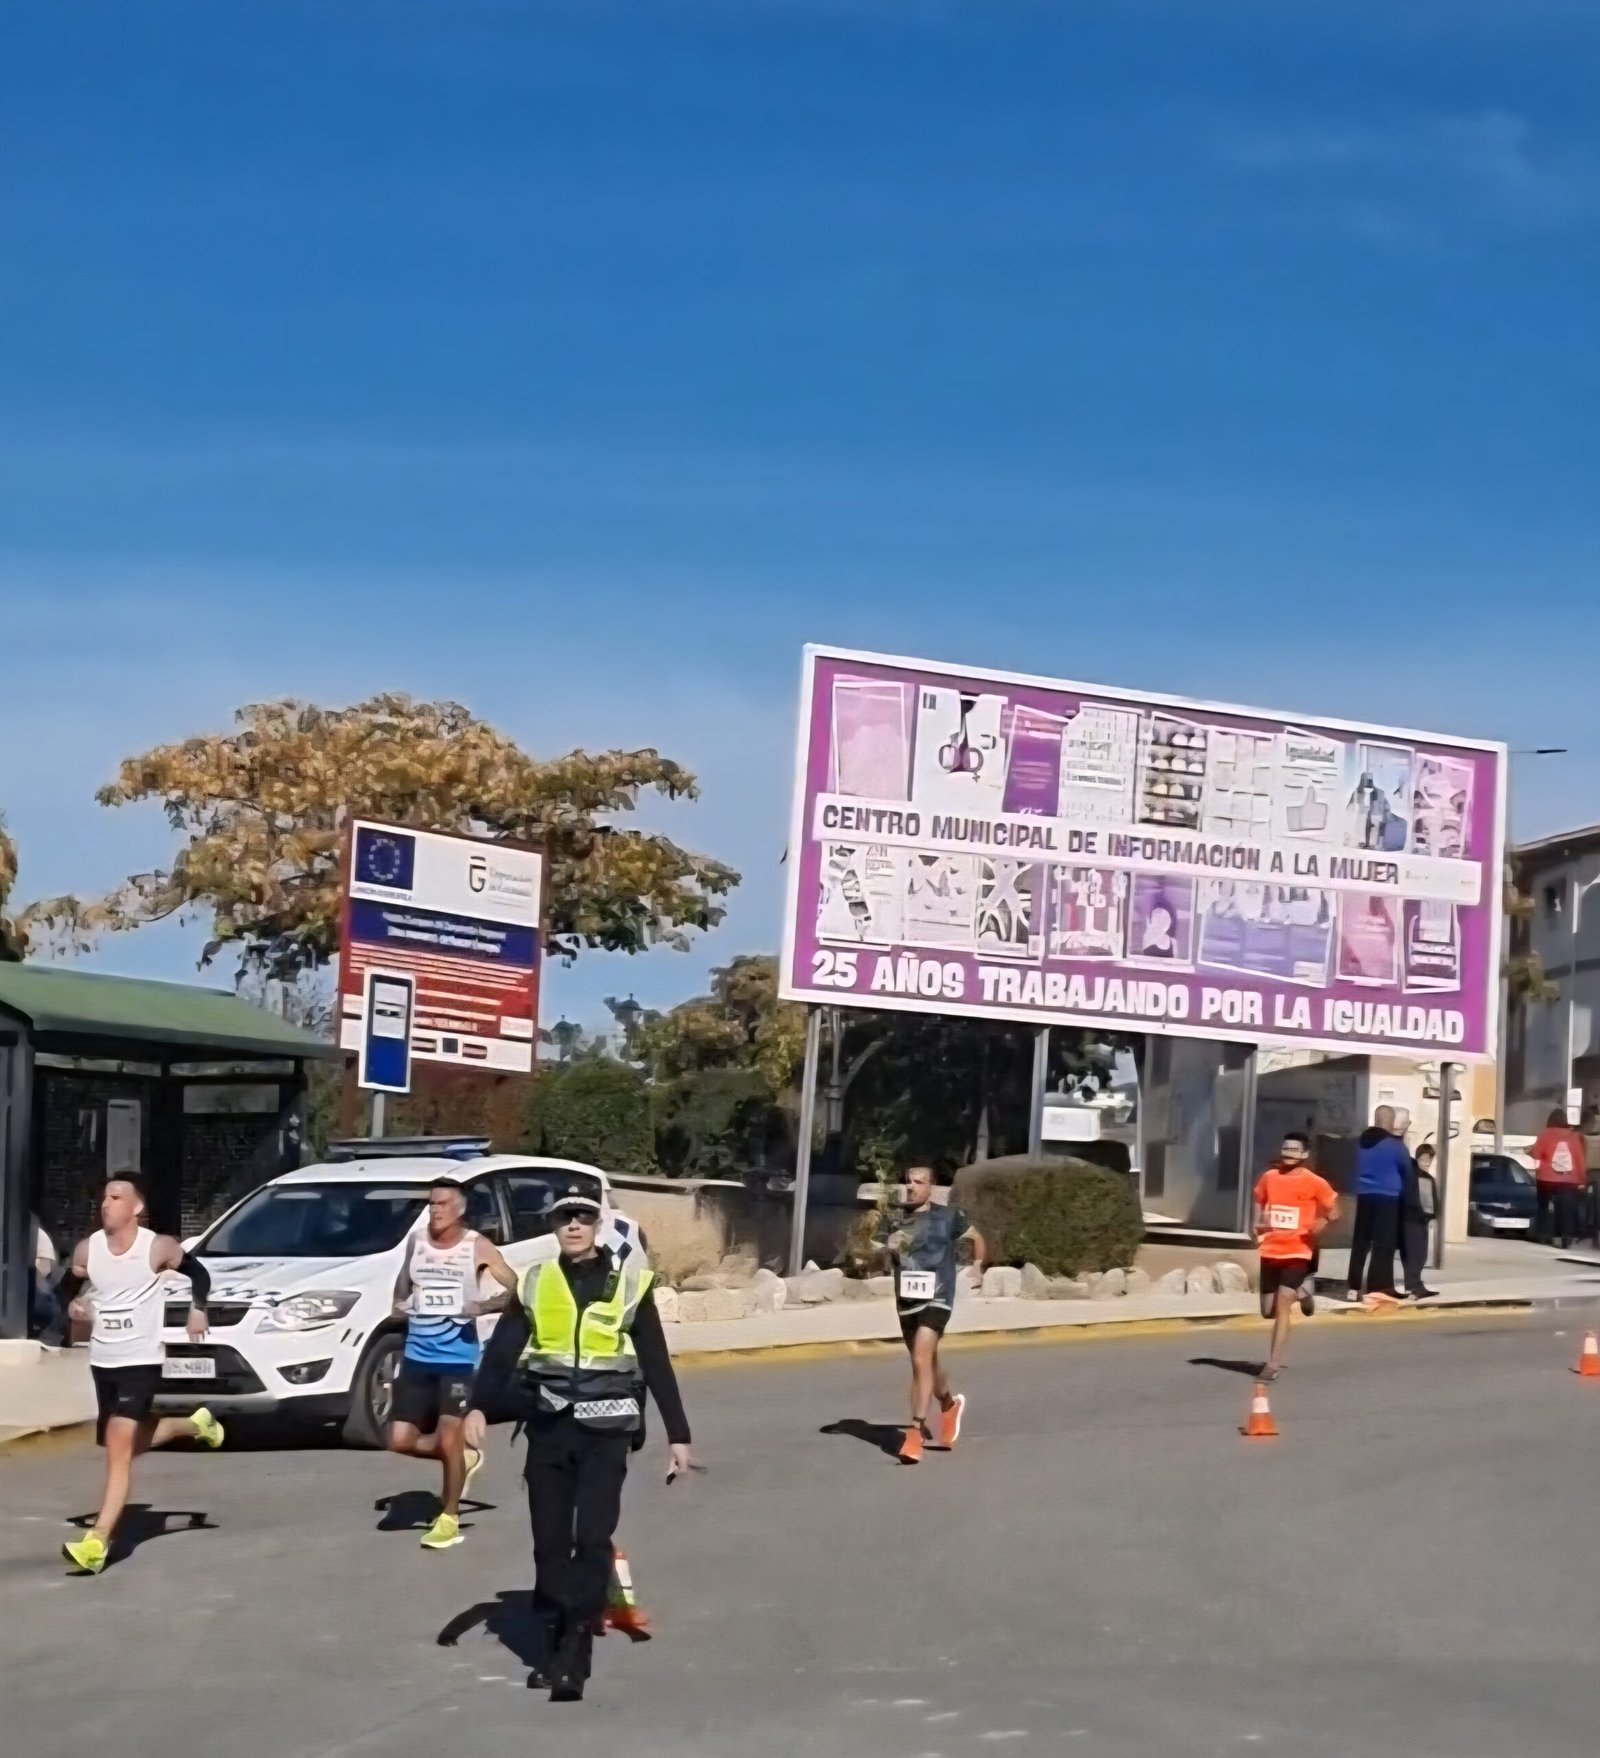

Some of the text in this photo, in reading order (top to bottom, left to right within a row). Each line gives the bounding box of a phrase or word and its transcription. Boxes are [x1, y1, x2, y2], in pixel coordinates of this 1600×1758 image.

[823, 805, 920, 836] CENTRO
[932, 815, 1057, 850] MUNICIPAL
[1068, 829, 1097, 854] DE
[1108, 833, 1260, 871] INFORMACIÓN
[1270, 851, 1284, 873] A
[1294, 853, 1319, 877] LA
[1330, 857, 1398, 885] MUJER
[811, 950, 1464, 1043] 25 AÑOS TRABAJANDO POR LA IGUALDAD
